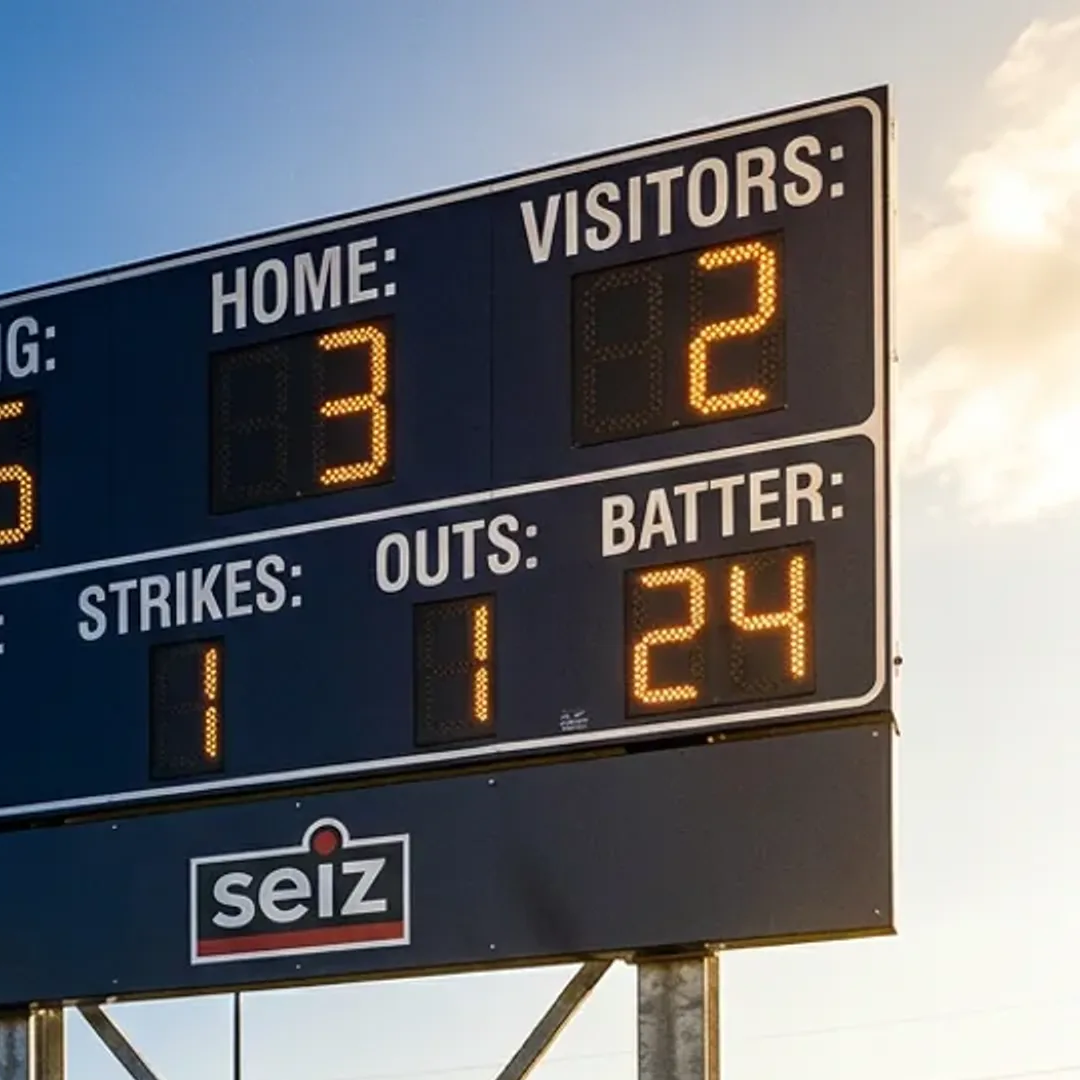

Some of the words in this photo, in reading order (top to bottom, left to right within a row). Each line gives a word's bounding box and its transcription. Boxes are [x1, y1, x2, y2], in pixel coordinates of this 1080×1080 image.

[521, 136, 843, 264] VISITORS:
[212, 238, 396, 333] HOME:
[688, 242, 777, 415] 2
[319, 326, 387, 485] 3
[375, 514, 538, 593] OUTS:
[601, 462, 843, 558] BATTER:
[78, 554, 302, 641] STRIKES:
[632, 556, 807, 705] 24
[203, 648, 218, 757] 1
[473, 604, 489, 722] 1
[212, 826, 388, 929] seiz
